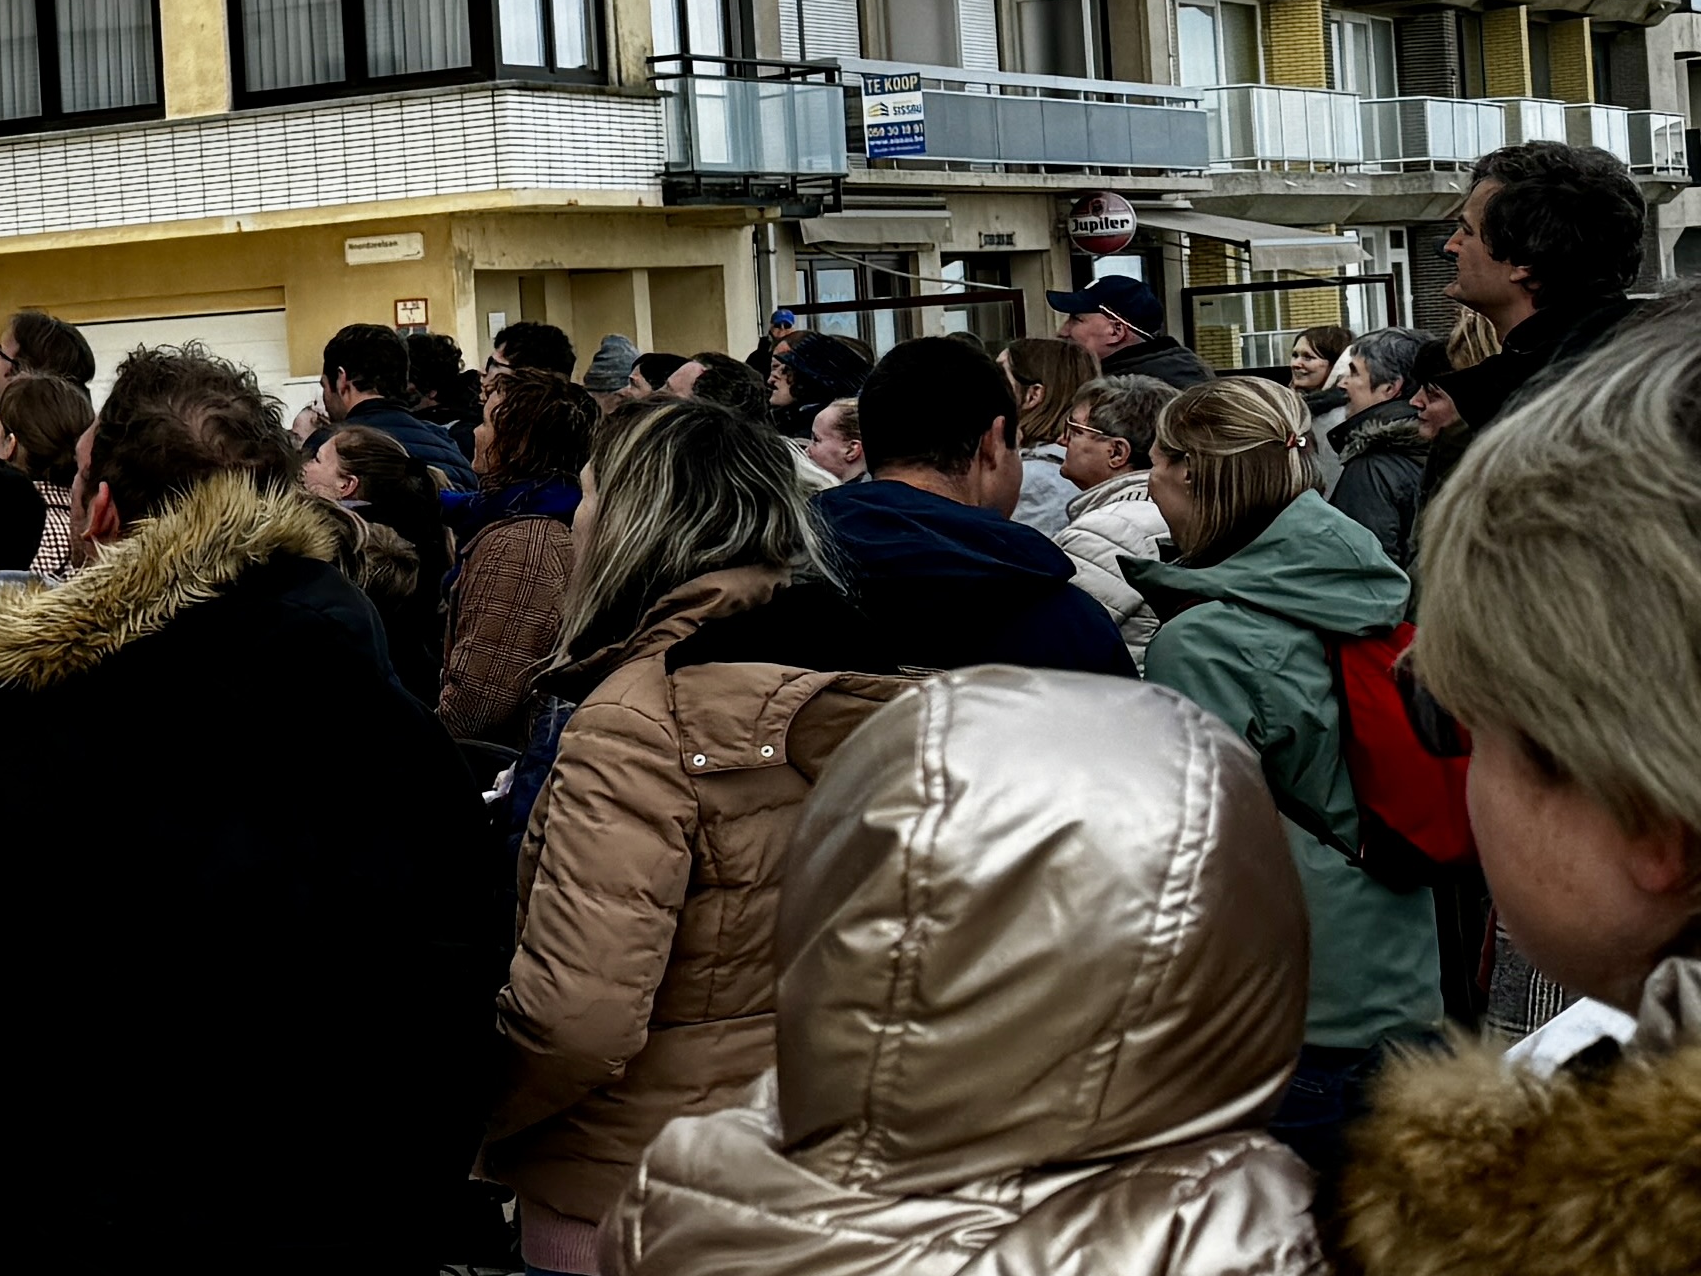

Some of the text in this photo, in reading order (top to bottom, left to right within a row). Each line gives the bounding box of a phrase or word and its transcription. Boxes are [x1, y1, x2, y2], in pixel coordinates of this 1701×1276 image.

[866, 75, 918, 94] TE KOOP
[1072, 217, 1130, 234] Jupiler
